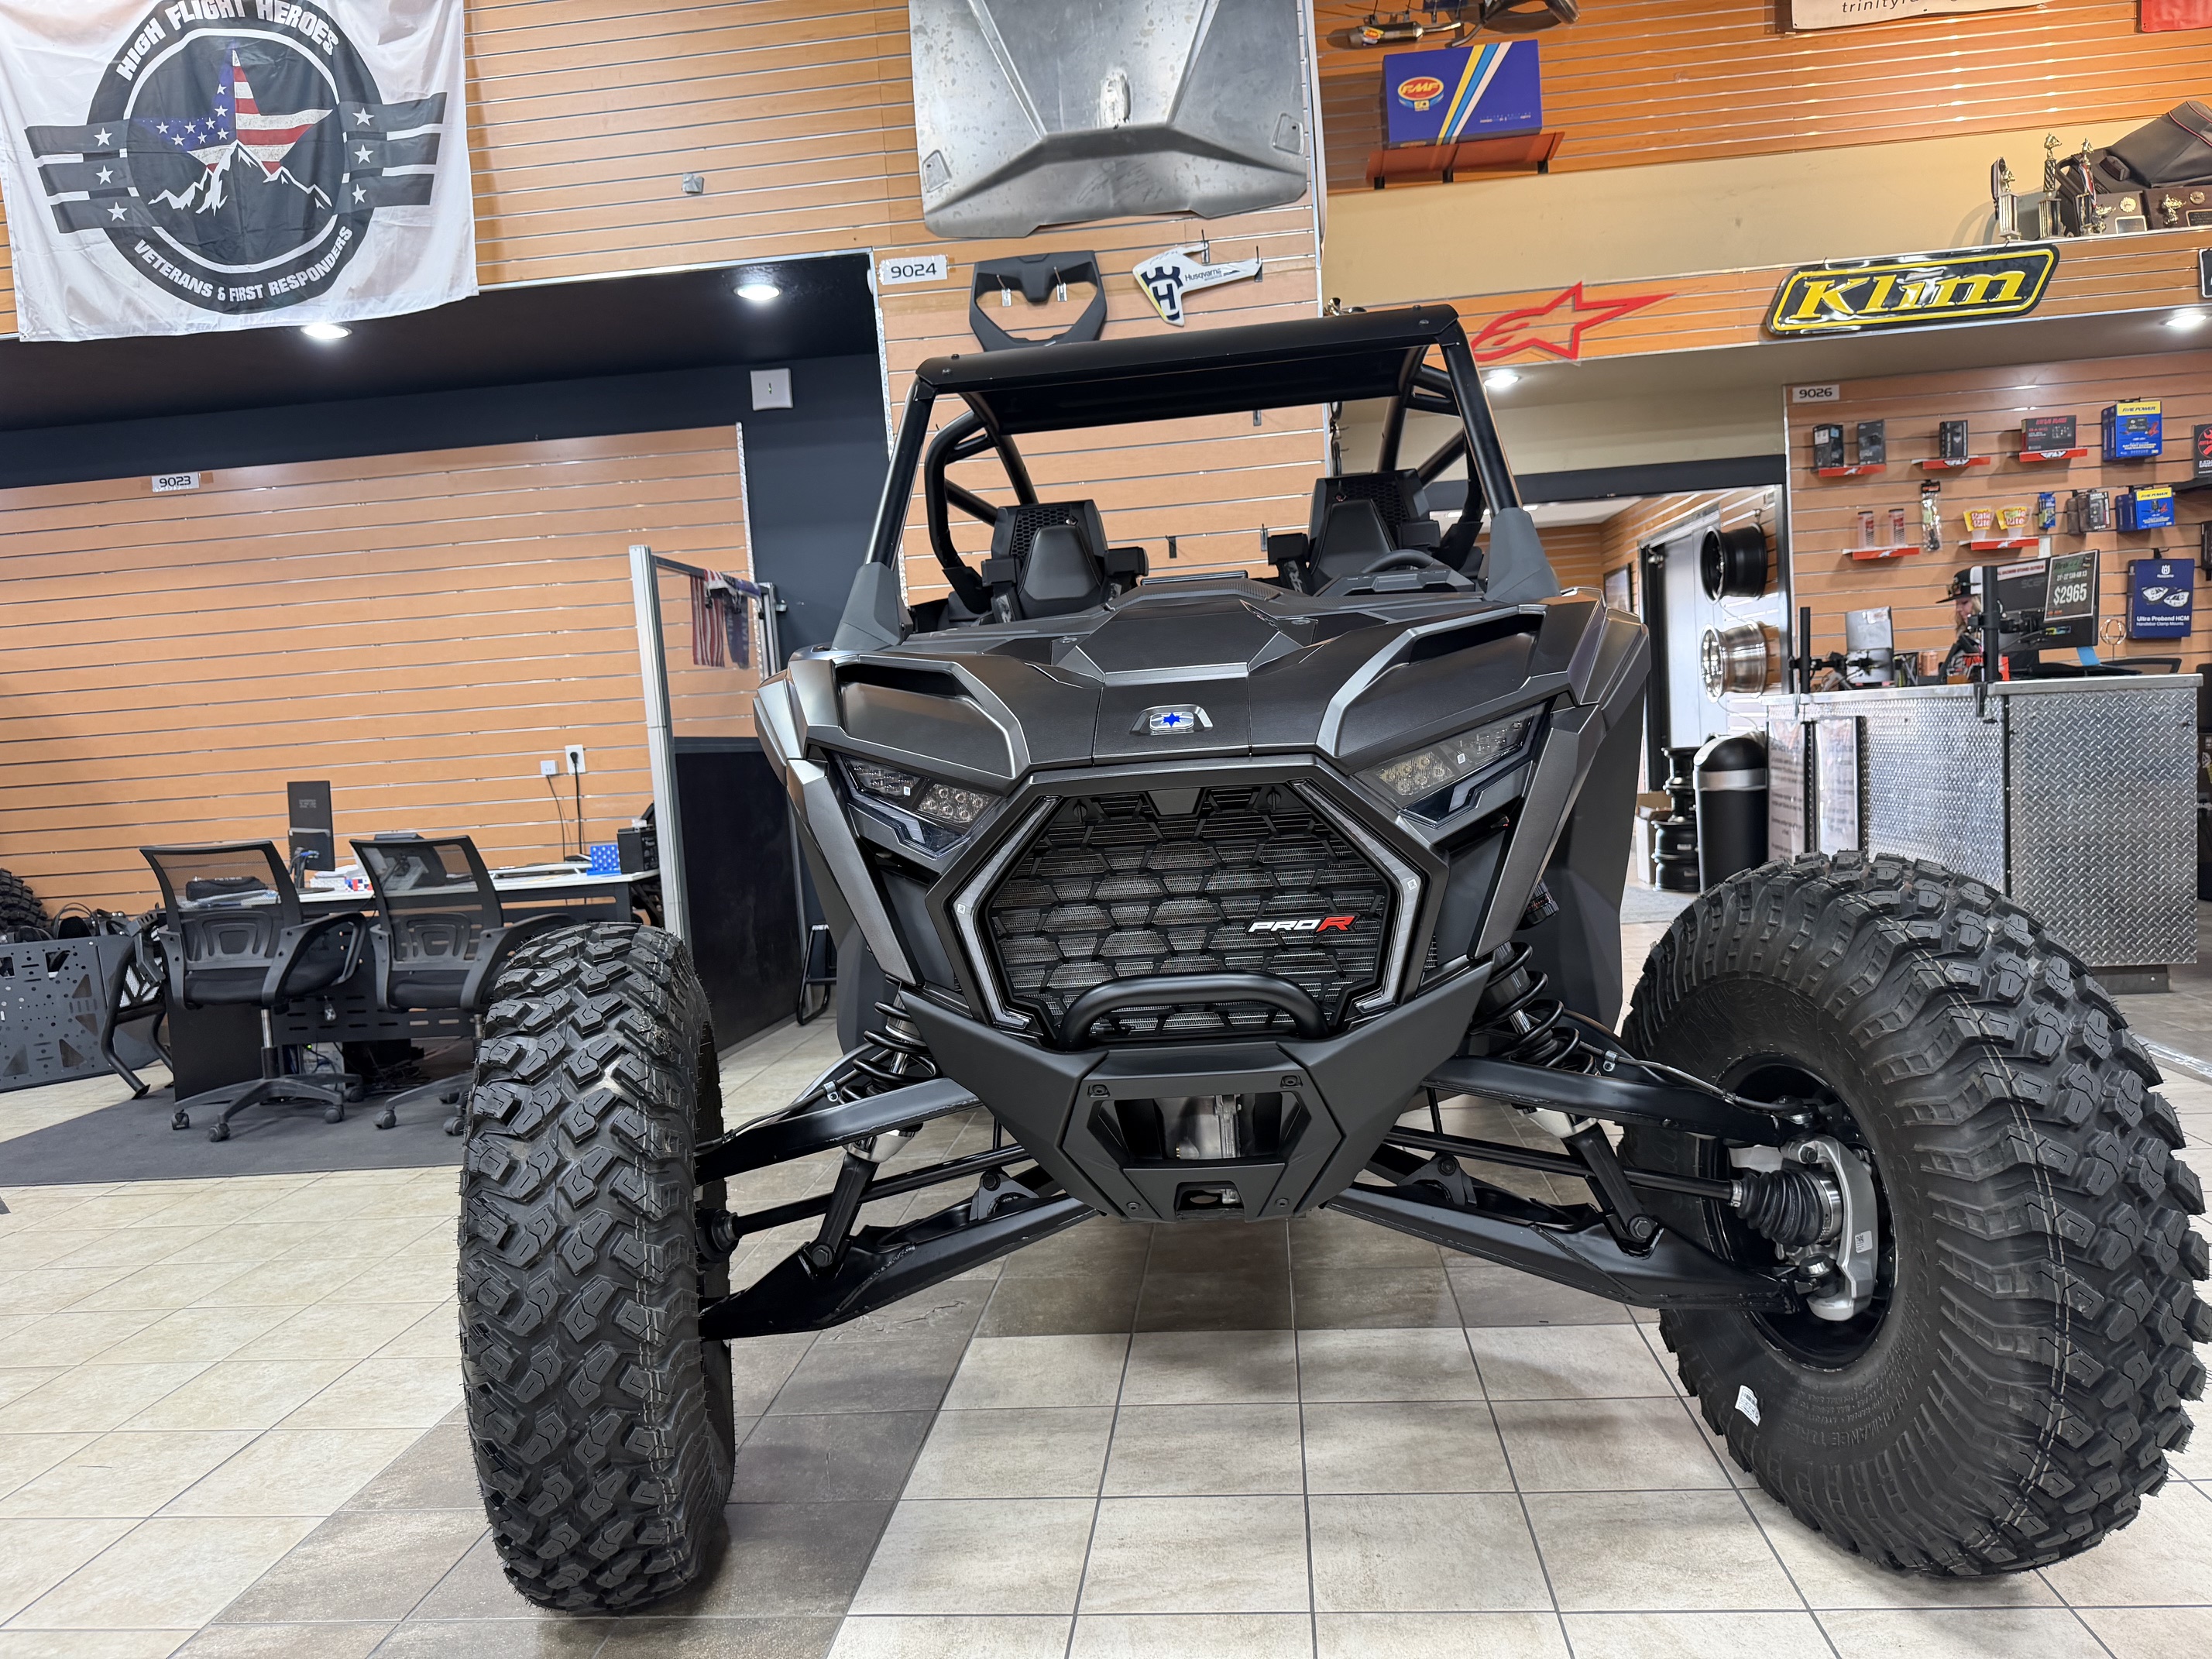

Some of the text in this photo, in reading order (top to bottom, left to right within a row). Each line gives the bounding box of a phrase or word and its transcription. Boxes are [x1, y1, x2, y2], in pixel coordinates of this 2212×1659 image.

[116, 0, 339, 81] HIGH FLIGHT HEROES
[1402, 82, 1440, 94] FMF
[133, 225, 353, 302] VETERANS & FIRST RESPONDERS
[891, 263, 937, 279] 9024
[1789, 270, 2026, 321] Klim
[1799, 387, 1832, 399] 9026
[159, 476, 191, 488] 9023
[2053, 582, 2087, 606] $2965
